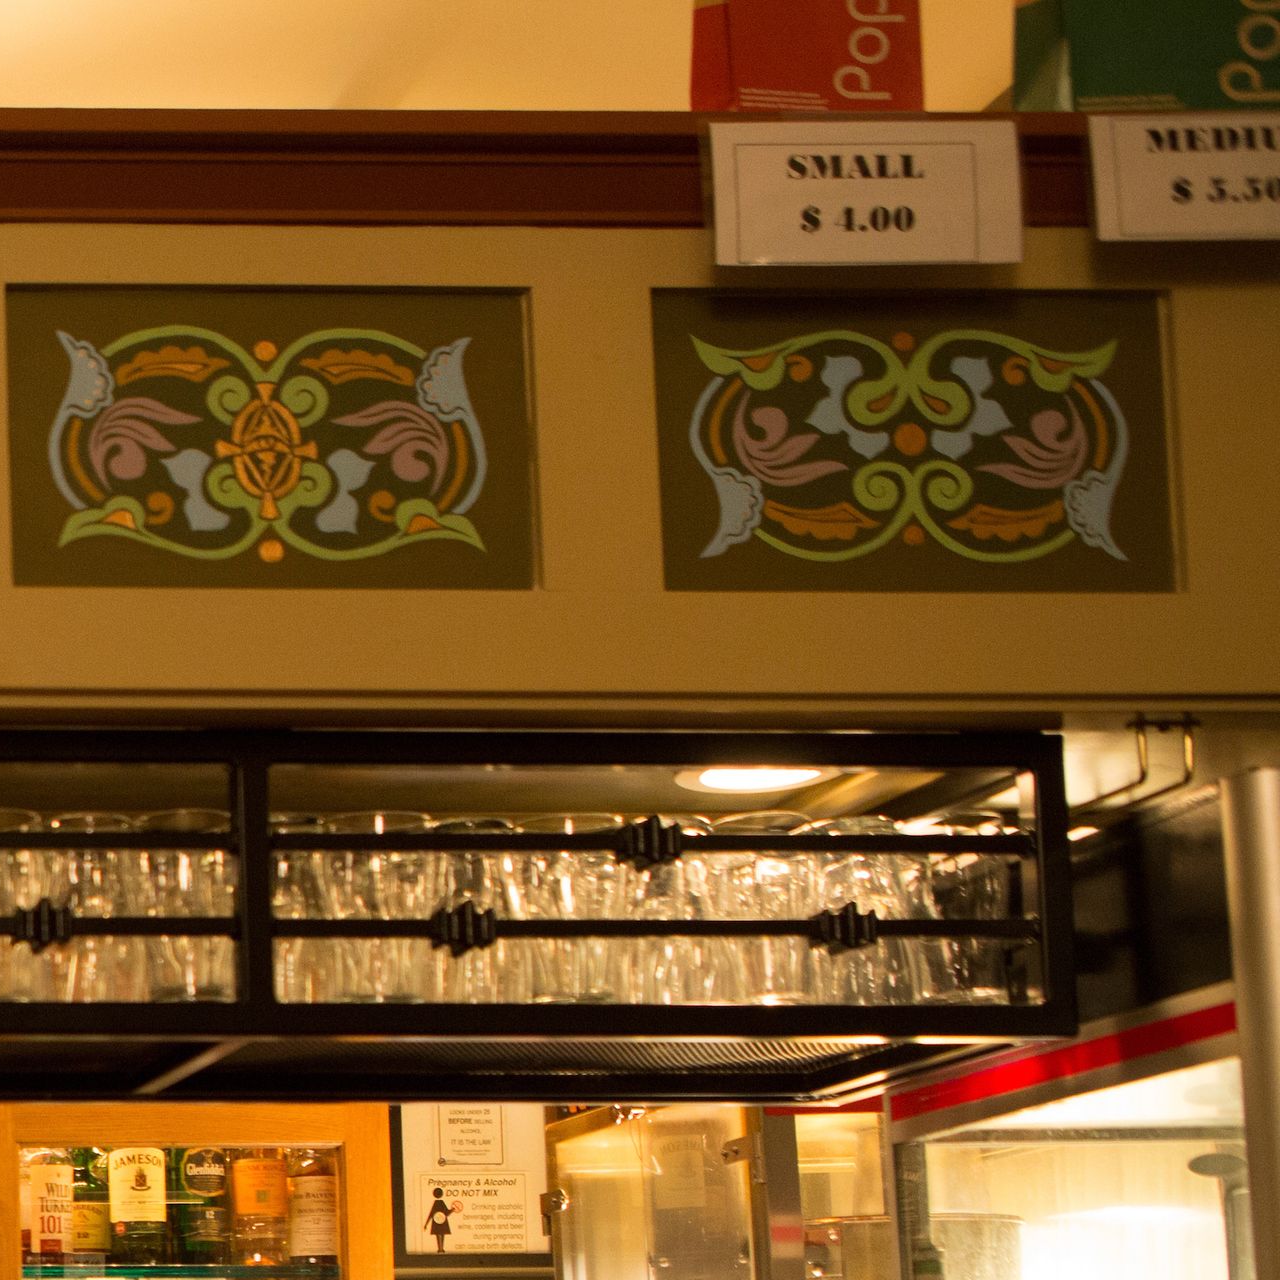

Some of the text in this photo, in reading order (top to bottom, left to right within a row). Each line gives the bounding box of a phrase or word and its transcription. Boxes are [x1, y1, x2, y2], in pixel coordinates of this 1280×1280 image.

[786, 152, 925, 180] SMALL
[1171, 175, 1192, 206] $
[800, 204, 917, 234] $ 4.00
[428, 1178, 517, 1187] Pregnancy & Alcohol
[446, 1189, 499, 1197] DO NOT MIX
[39, 1215, 63, 1234] 101
